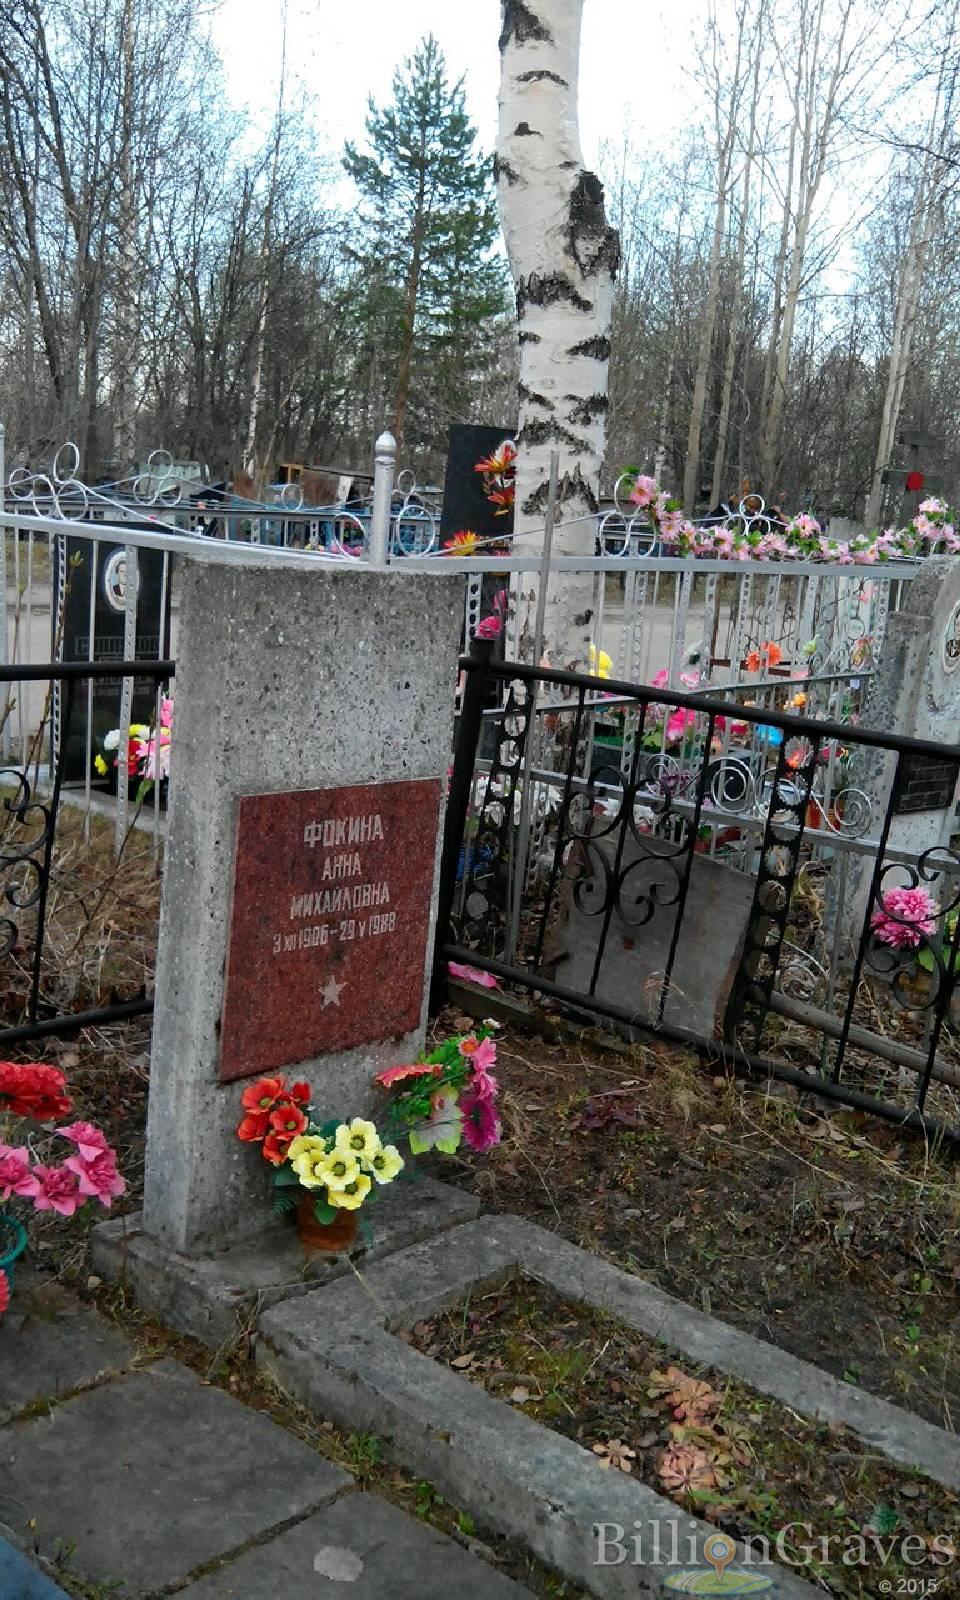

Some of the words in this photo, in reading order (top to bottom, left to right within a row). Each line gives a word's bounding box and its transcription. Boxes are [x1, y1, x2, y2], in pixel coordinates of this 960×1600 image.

[303, 814, 384, 848] ФОКИНА
[321, 852, 362, 880] АННА
[289, 881, 390, 920] МИХАЙЛОВНА
[272, 933, 281, 955] 3
[368, 911, 397, 937] 1988
